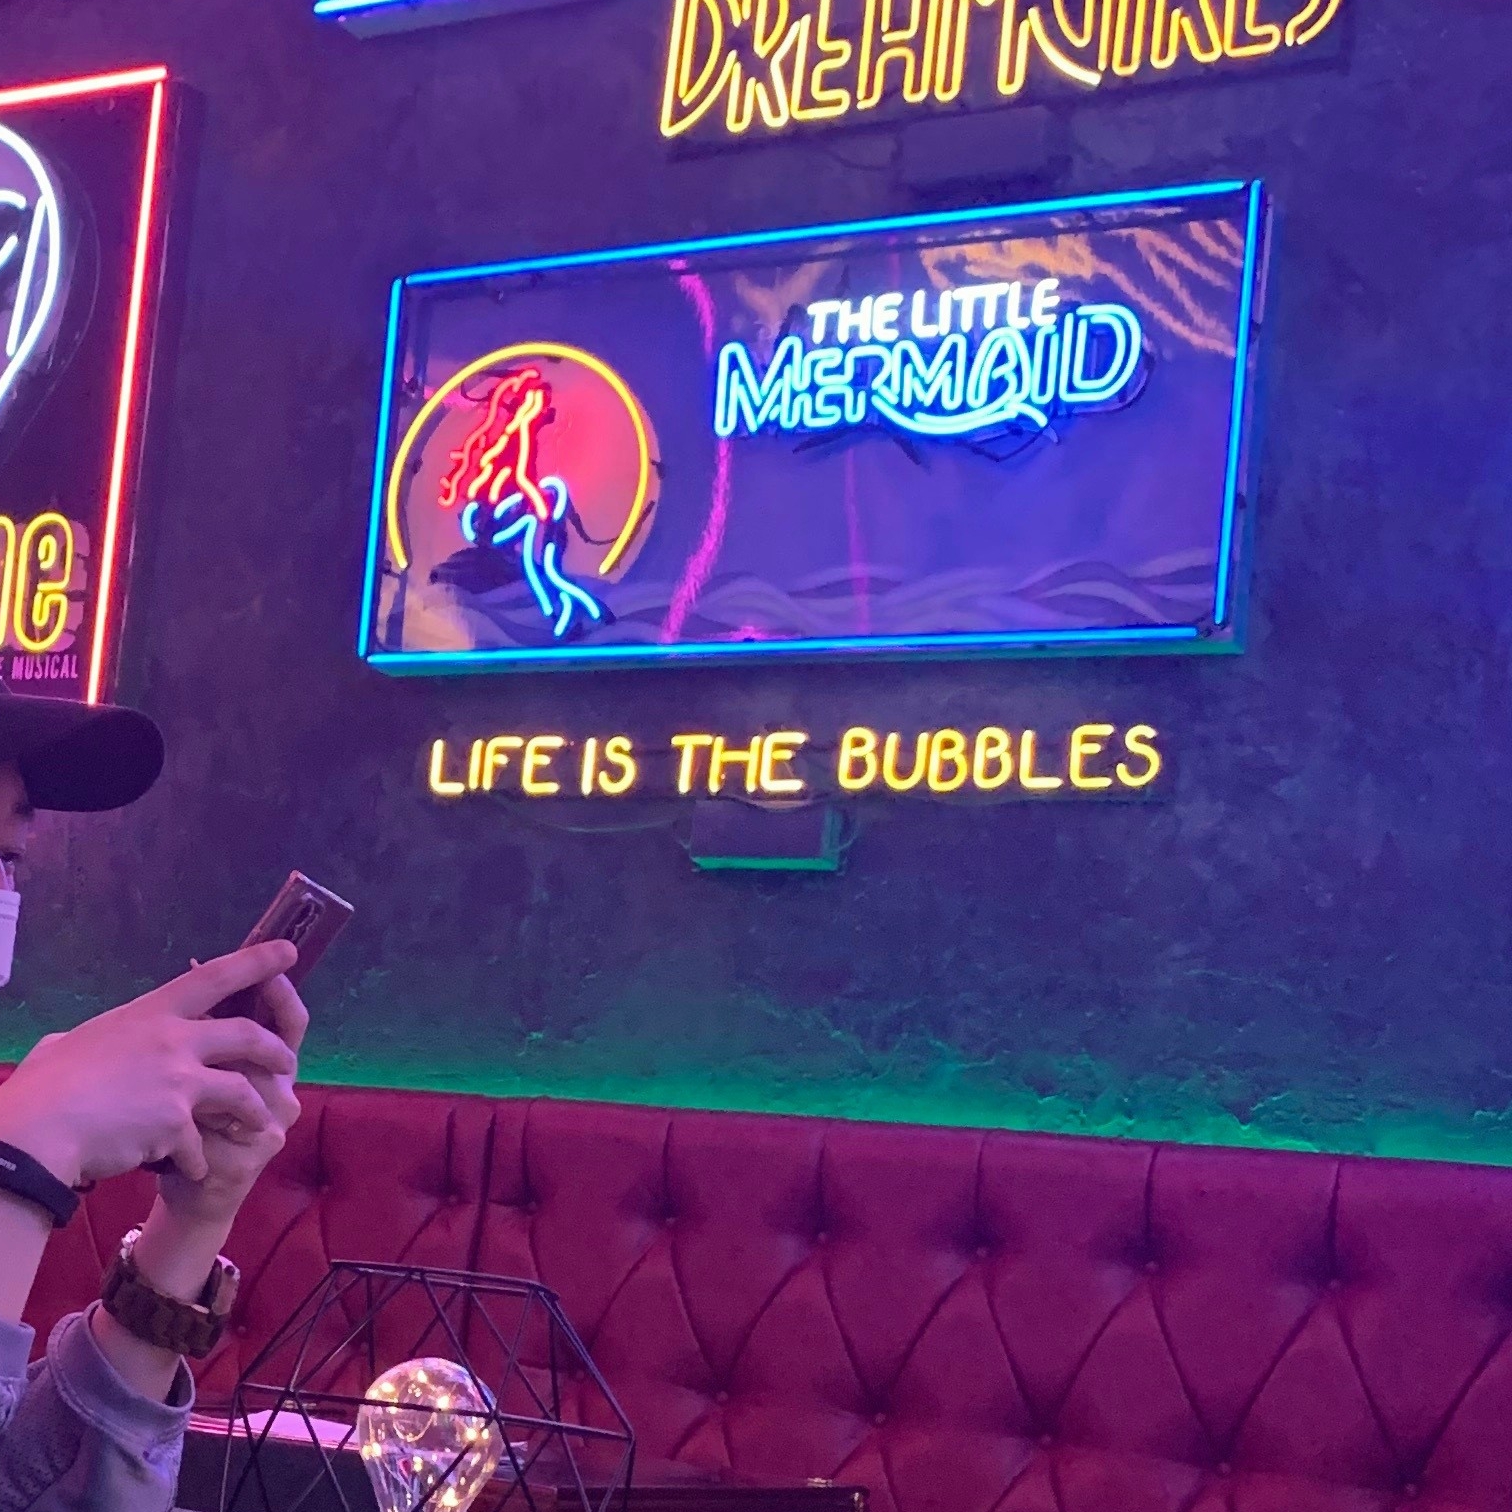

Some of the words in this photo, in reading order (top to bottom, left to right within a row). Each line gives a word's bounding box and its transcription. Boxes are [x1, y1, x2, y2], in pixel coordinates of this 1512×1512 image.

[805, 292, 903, 345] THE
[910, 277, 1060, 337] LITTLE
[11, 654, 79, 681] MUSICAL
[429, 735, 564, 794] LIFE
[581, 735, 637, 795] IS
[670, 732, 807, 795] THE
[837, 724, 1162, 792] BUBBLES
